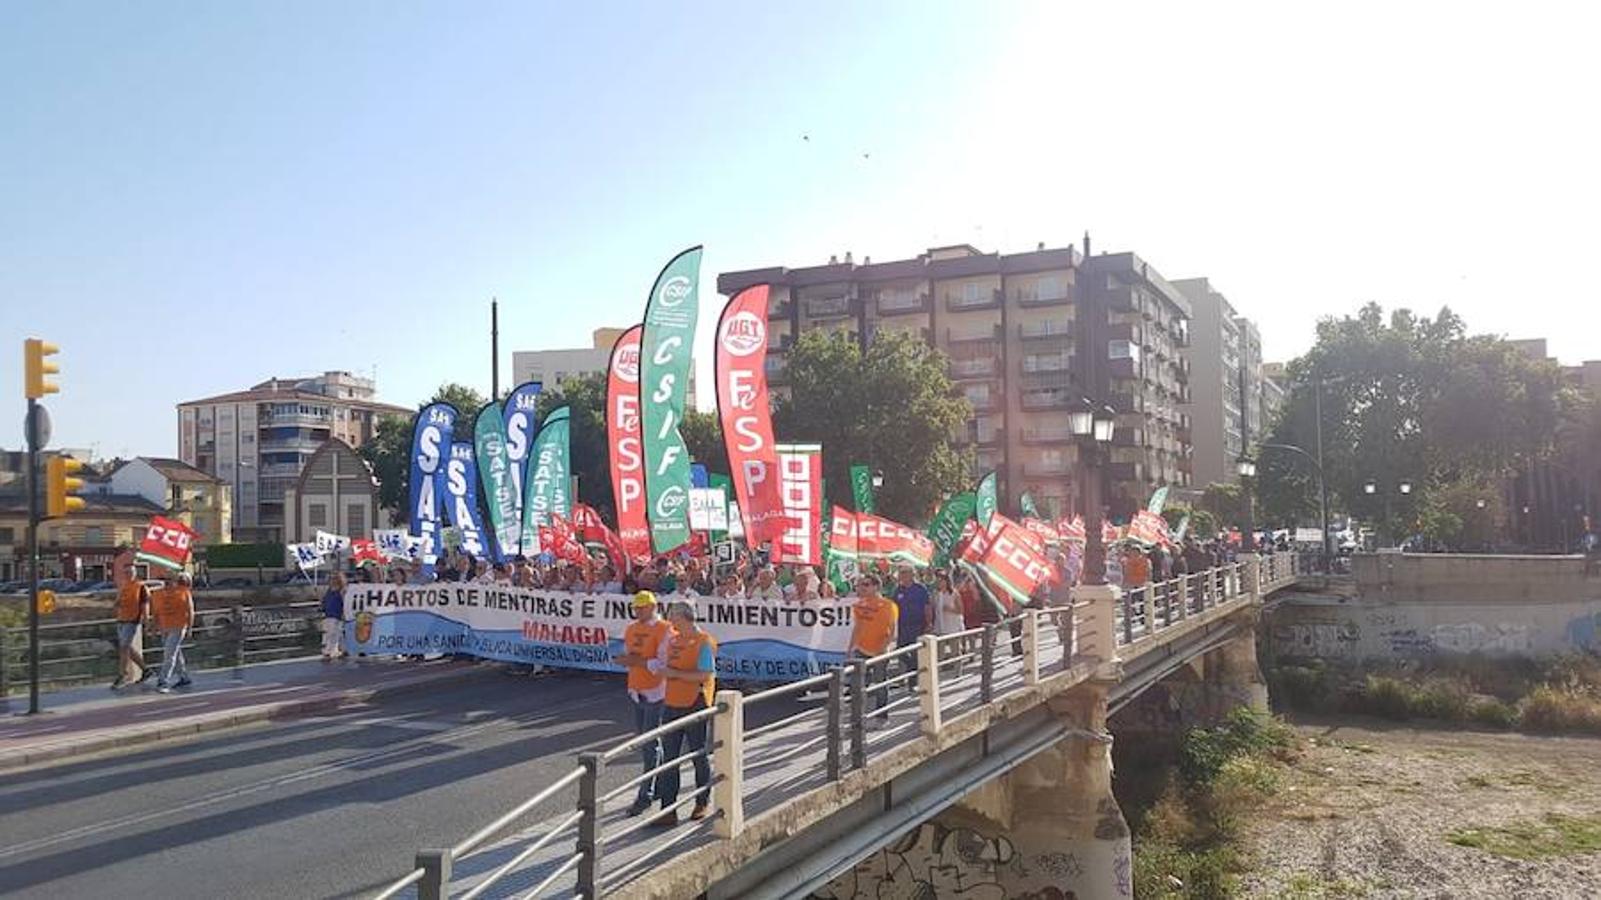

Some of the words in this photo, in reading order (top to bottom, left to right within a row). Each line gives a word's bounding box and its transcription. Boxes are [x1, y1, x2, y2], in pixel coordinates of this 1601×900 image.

[653, 336, 682, 476] CSIF
[484, 590, 573, 618] MENTIRAS
[581, 600, 595, 619] E
[378, 635, 404, 649] POR
[766, 661, 787, 676] DE
